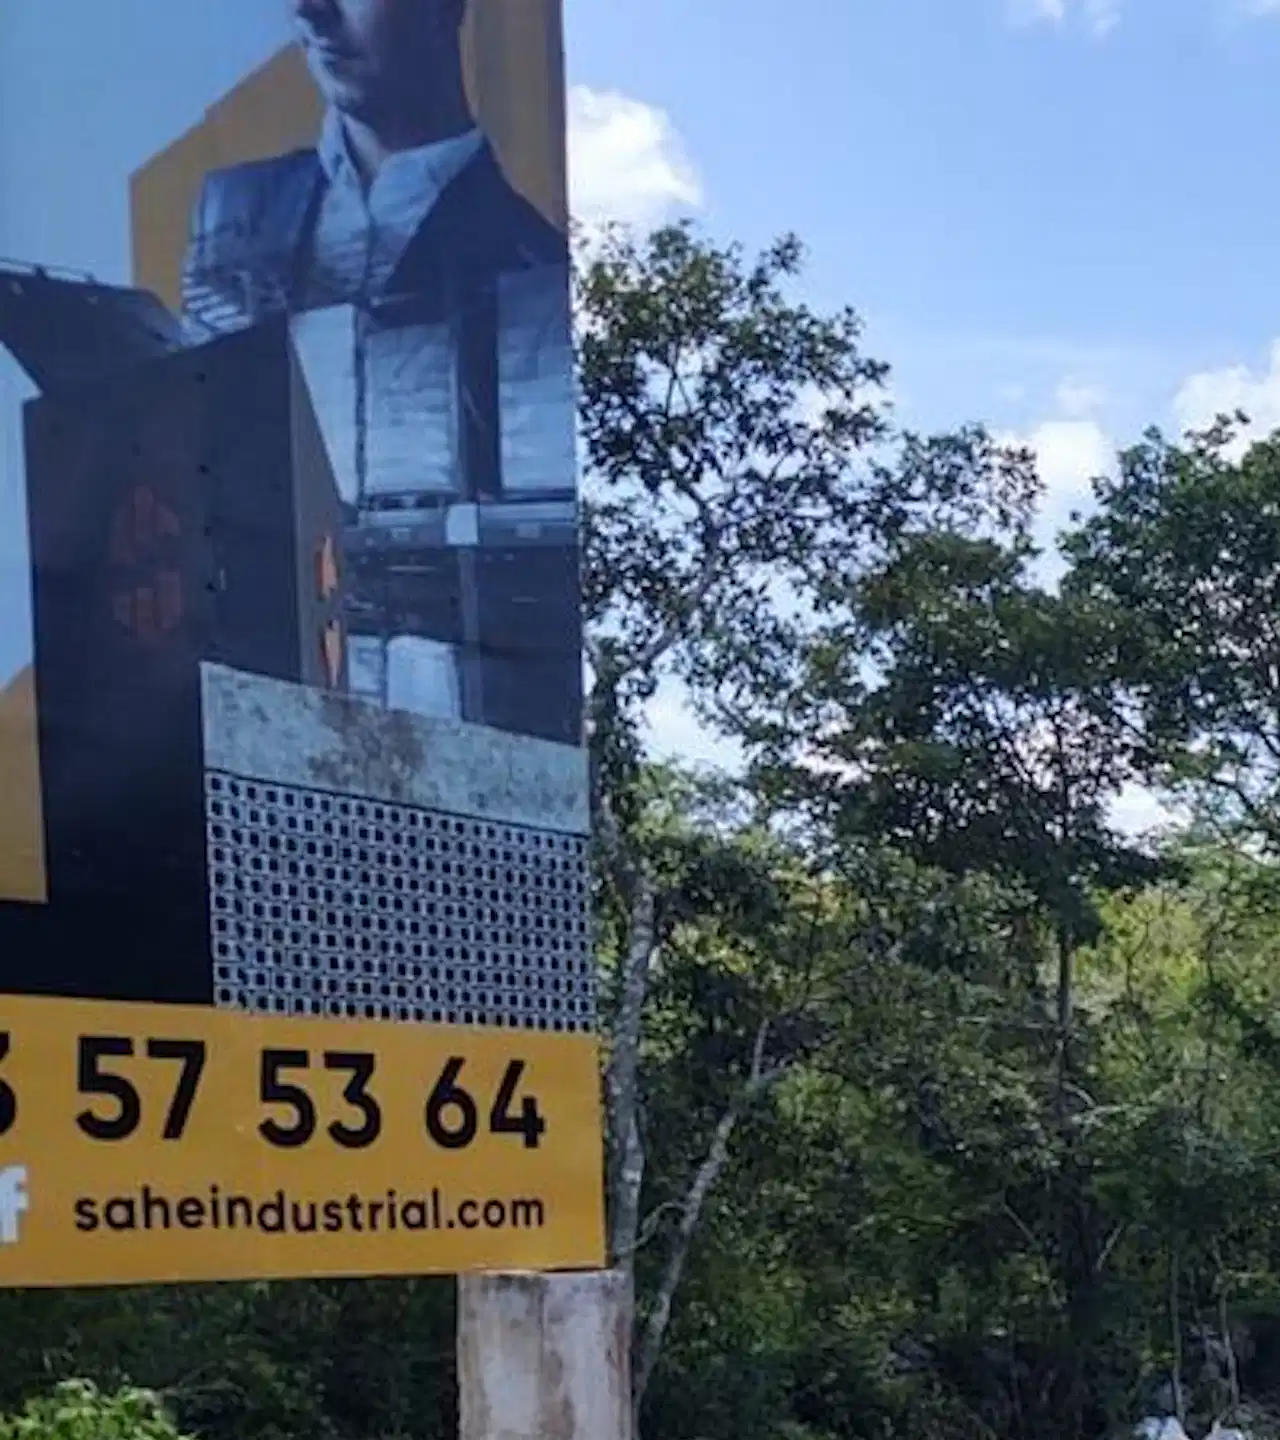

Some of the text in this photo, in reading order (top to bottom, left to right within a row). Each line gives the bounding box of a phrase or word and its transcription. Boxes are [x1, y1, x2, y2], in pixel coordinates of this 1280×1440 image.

[74, 1036, 206, 1141] 57
[257, 1049, 382, 1149] 53
[424, 1056, 546, 1150] 64
[74, 1184, 544, 1233] saheindustrial.com
